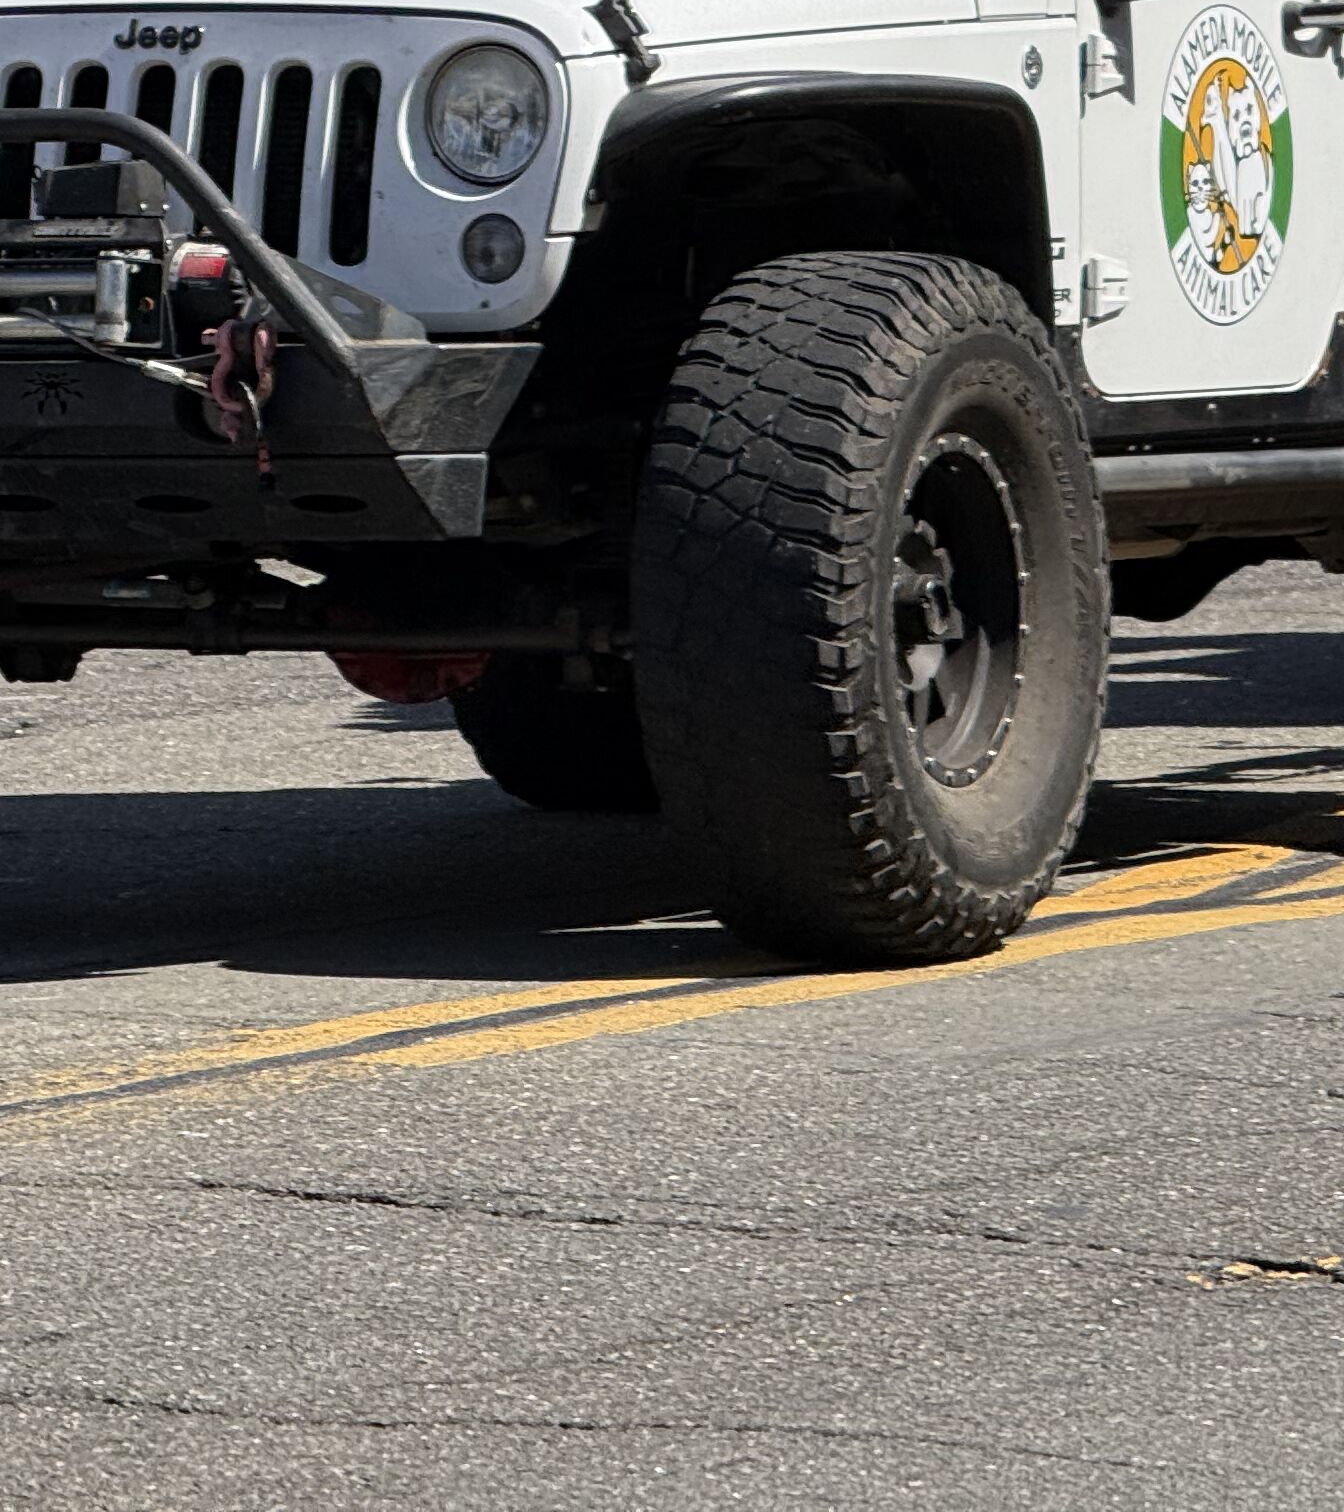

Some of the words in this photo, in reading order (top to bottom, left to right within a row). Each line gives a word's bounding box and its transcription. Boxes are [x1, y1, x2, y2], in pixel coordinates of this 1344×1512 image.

[113, 18, 202, 55] Jeep
[1167, 12, 1229, 117] ALAMEDA
[1232, 16, 1284, 112] MOBILE
[1175, 241, 1238, 317] ANIMAL
[1242, 239, 1282, 310] CARE
